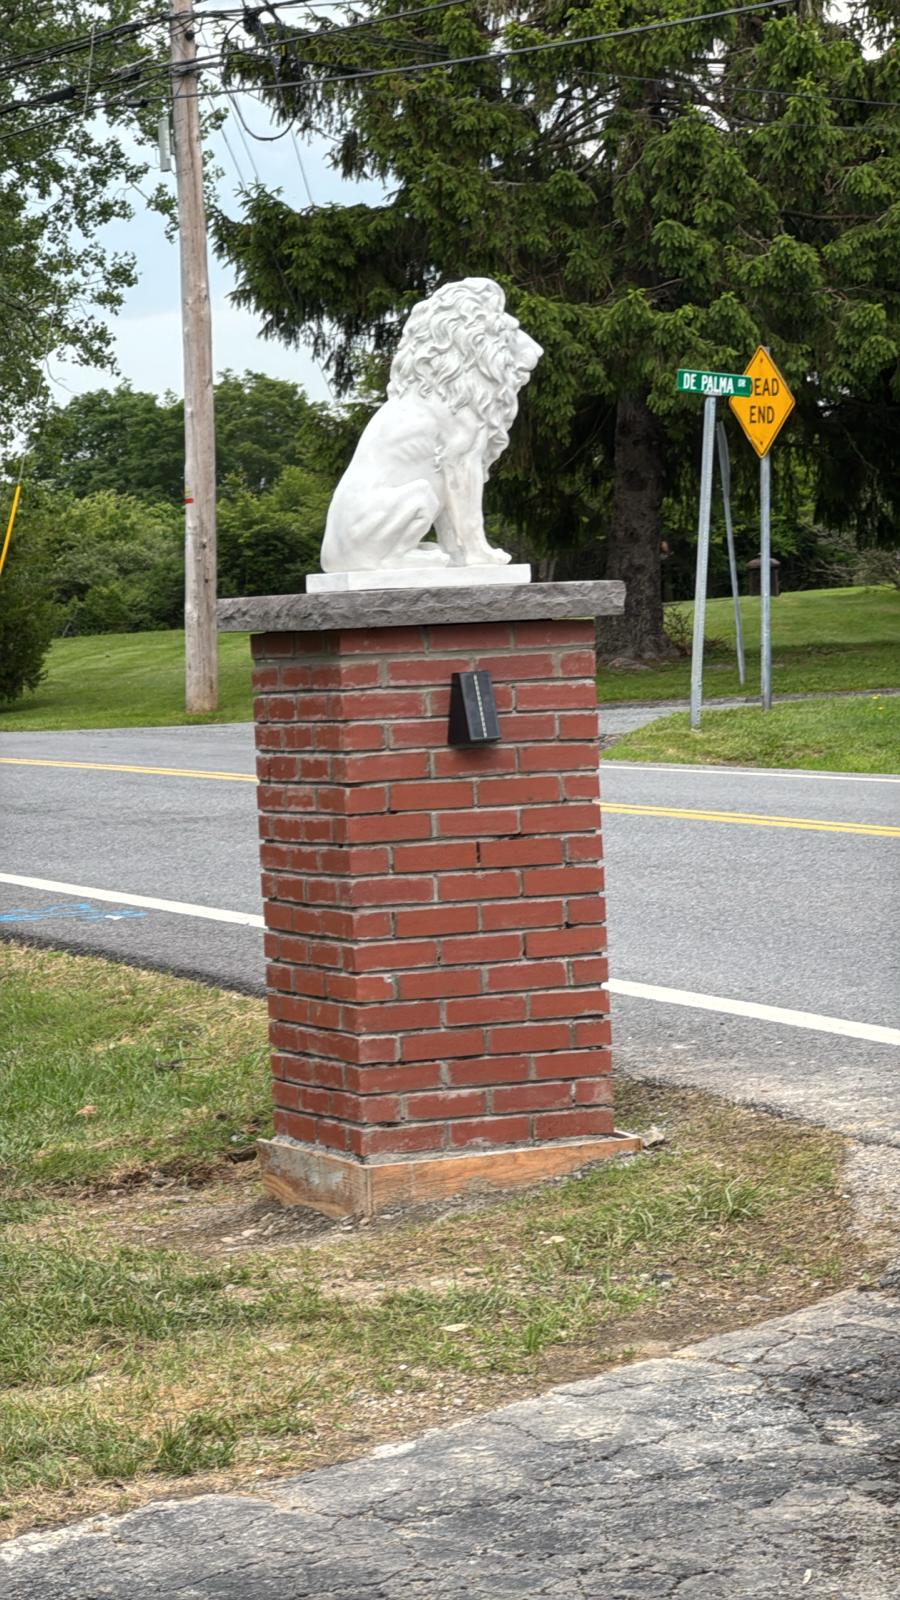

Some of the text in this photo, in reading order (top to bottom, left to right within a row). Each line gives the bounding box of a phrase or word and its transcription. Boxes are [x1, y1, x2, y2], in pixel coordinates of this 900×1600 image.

[683, 373, 697, 389] DE
[701, 375, 734, 393] PALMA
[753, 378, 779, 396] EAD
[749, 405, 775, 424] END
